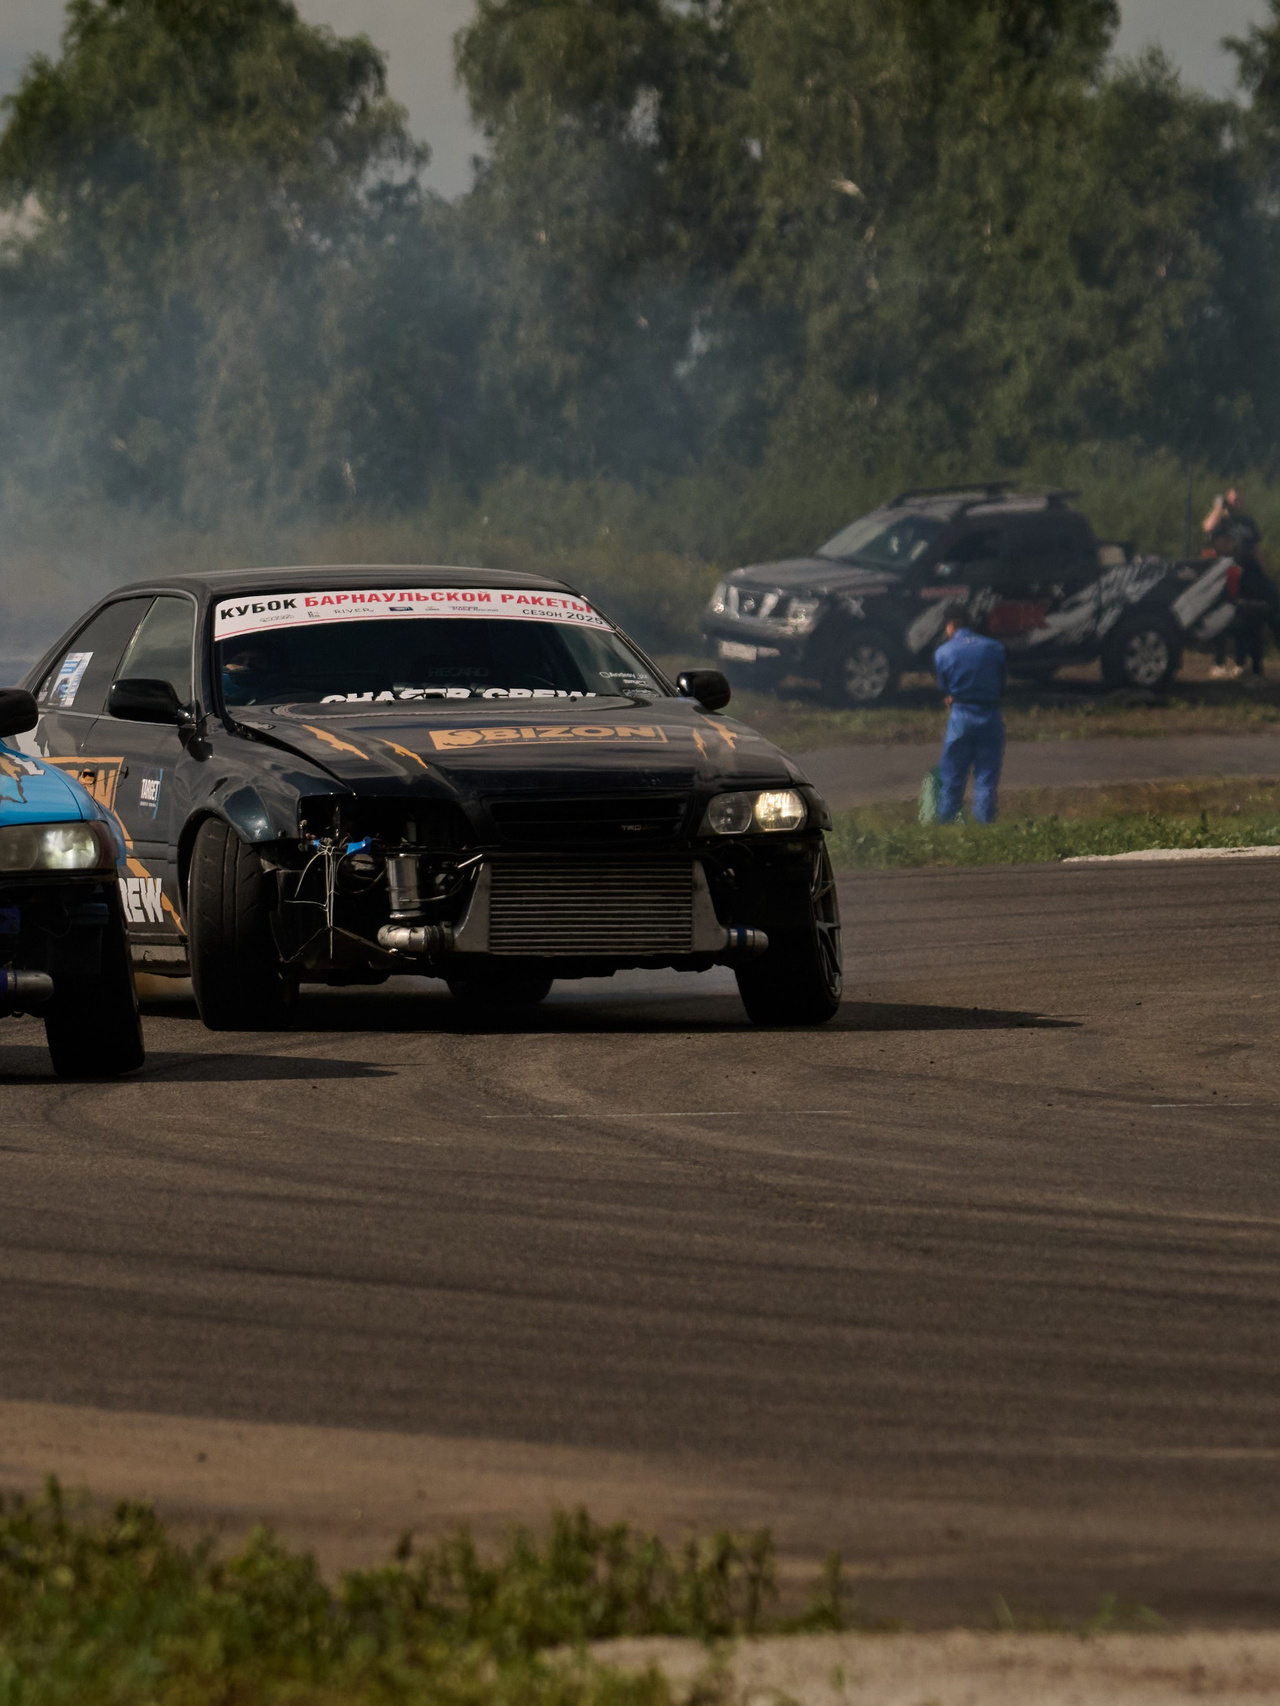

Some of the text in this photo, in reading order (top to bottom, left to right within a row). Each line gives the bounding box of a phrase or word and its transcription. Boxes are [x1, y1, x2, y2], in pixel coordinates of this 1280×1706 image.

[220, 598, 297, 620] КУБОК
[304, 591, 491, 608] БАРНАУЛЬСКОЙ
[501, 593, 592, 613] РАКЕТЫ
[522, 608, 604, 625] СЕЗОН 2025
[482, 726, 657, 742] BIZON
